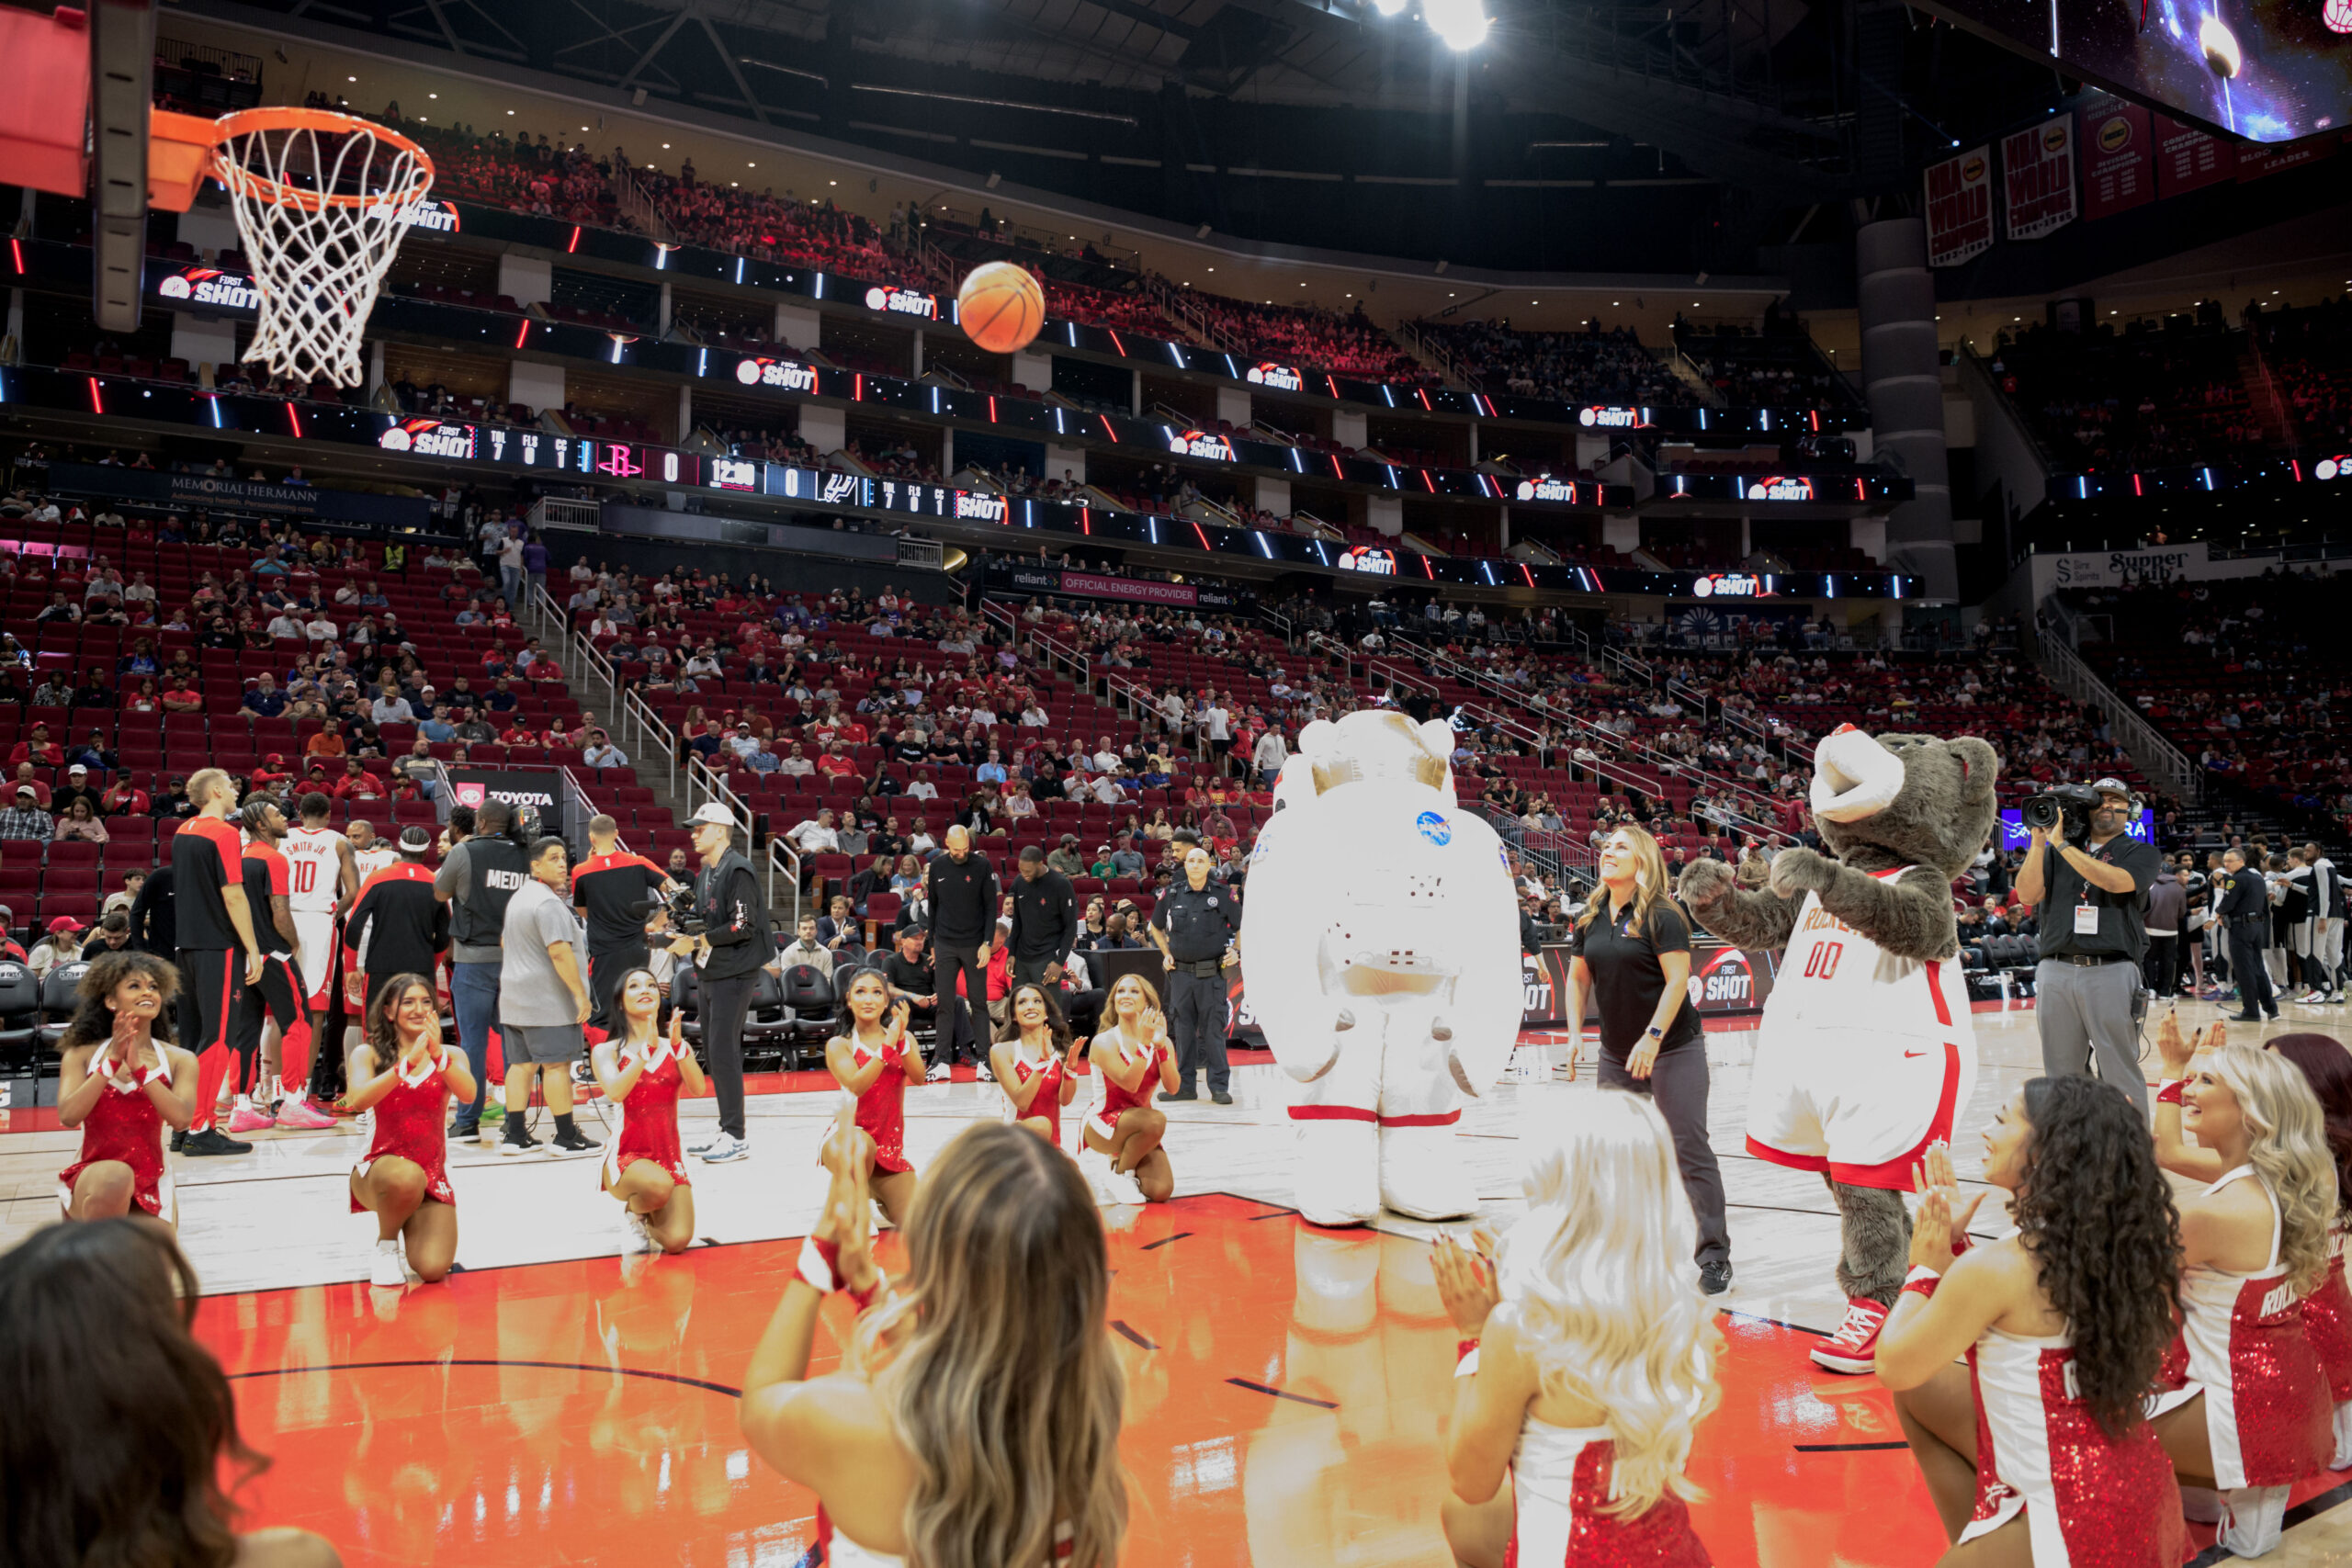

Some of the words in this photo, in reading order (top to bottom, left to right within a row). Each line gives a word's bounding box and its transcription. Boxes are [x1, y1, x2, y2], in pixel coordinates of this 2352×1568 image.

[219, 275, 243, 286] FIRST
[888, 292, 934, 316] SHOT
[763, 365, 815, 389] SHOT
[1264, 371, 1300, 390] SHOT
[1597, 411, 1634, 426] SHOT
[494, 443, 503, 460] 7
[557, 451, 565, 468] 1
[1190, 441, 1228, 460] SHOT
[664, 453, 678, 482] 0
[171, 477, 244, 495] MEMORIAL
[247, 485, 318, 502] HERMANN
[785, 468, 798, 497] 0
[1535, 483, 1573, 501] SHOT
[886, 493, 893, 509] 7
[1768, 485, 1810, 500] SHOT
[957, 496, 1006, 521] SHOT
[1357, 556, 1393, 574] SHOT
[2109, 553, 2188, 573] Supper
[1014, 572, 1047, 586] reliant
[1714, 578, 1757, 594] SHOT
[1065, 578, 1109, 592] OFFICIAL
[1111, 582, 1148, 596] ENERGY
[1148, 587, 1193, 601] PROVIDER
[1199, 592, 1229, 605] reliant
[489, 791, 554, 806] TOYOTA
[287, 841, 312, 855] SMITH
[294, 860, 317, 894] 10
[1721, 964, 1736, 975] FIRST
[1804, 941, 1844, 980] 00
[1706, 975, 1751, 1000] SHOT
